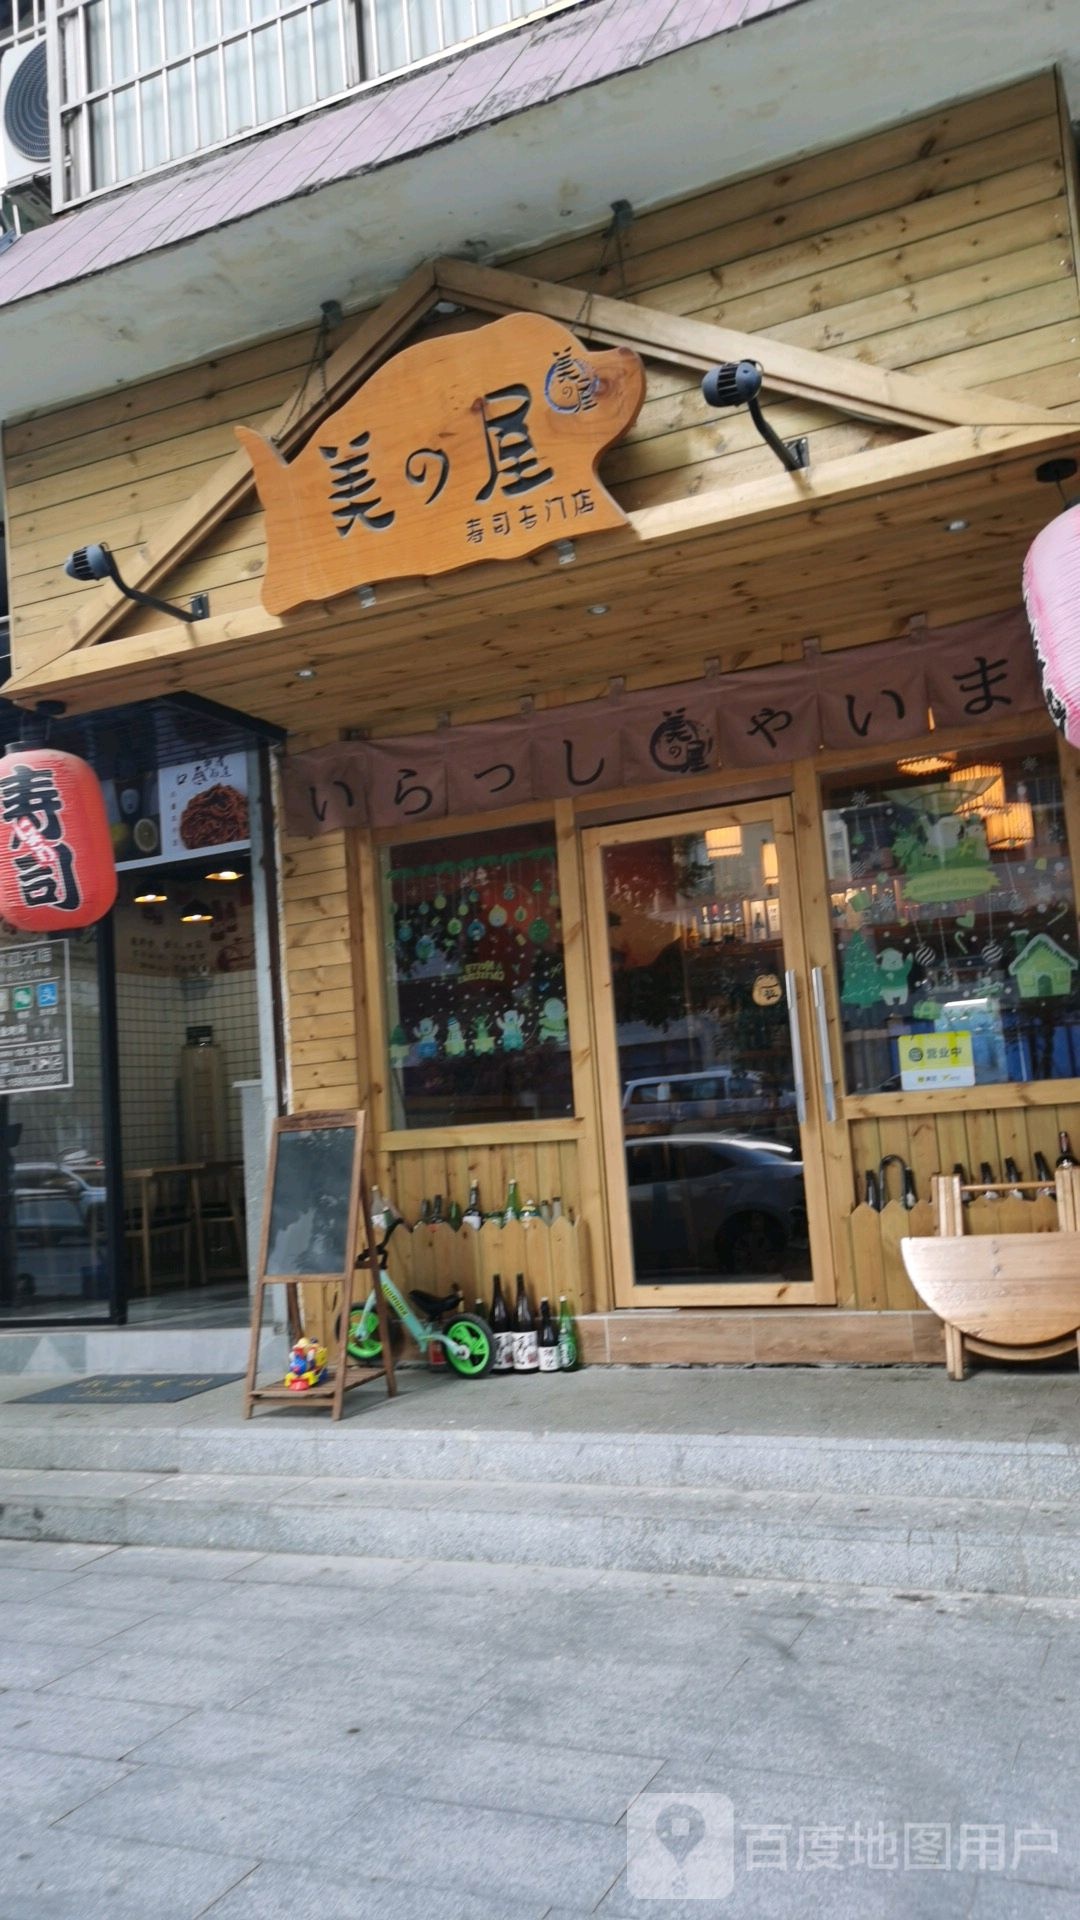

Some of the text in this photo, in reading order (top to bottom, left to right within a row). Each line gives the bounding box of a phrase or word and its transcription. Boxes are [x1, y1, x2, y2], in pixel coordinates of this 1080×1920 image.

[319, 383, 554, 538] 美の屋
[465, 488, 595, 544] 寿司专门店
[0, 765, 82, 911] 寿司
